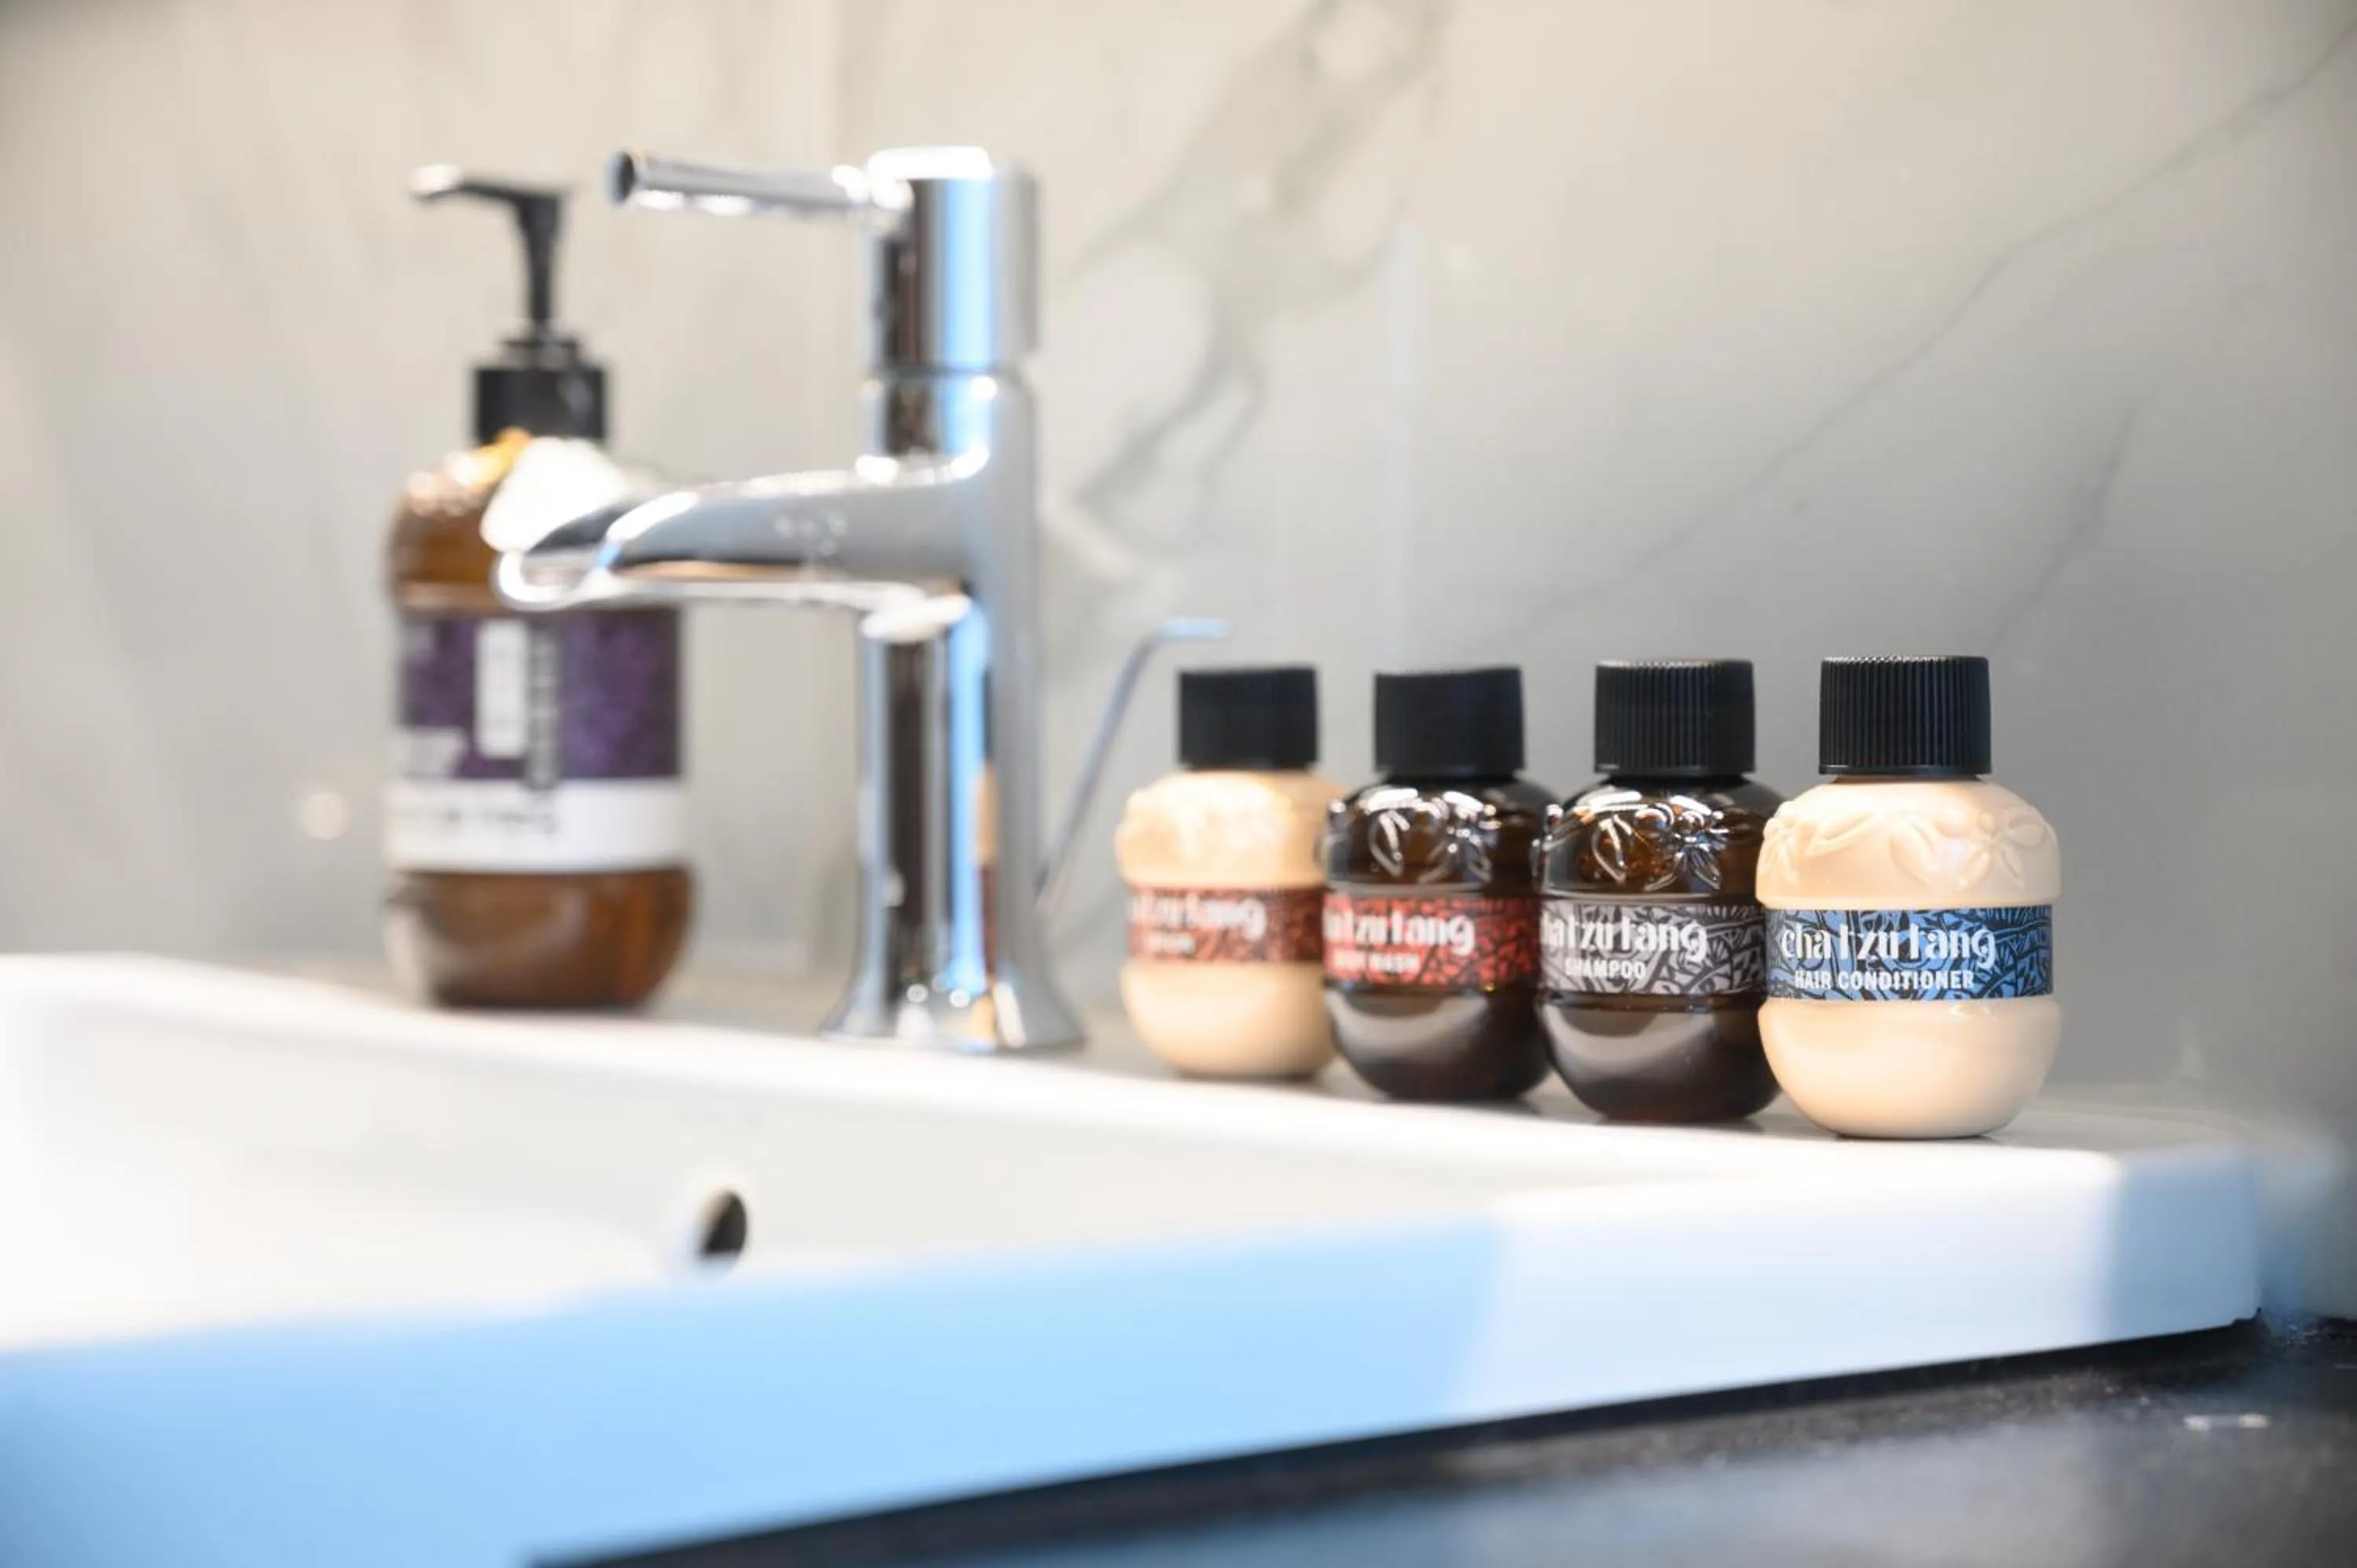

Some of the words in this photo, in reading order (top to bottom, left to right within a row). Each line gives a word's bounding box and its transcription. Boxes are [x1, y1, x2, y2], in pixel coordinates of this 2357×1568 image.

[1621, 914, 1708, 963] tang
[1780, 924, 1832, 960] cha
[1839, 923, 1900, 961] tzu
[1909, 923, 1997, 970] tang
[1564, 958, 1646, 979] SHAMPOO
[1794, 970, 1831, 990] HAIR
[1838, 970, 1975, 991] CONDITIONER
